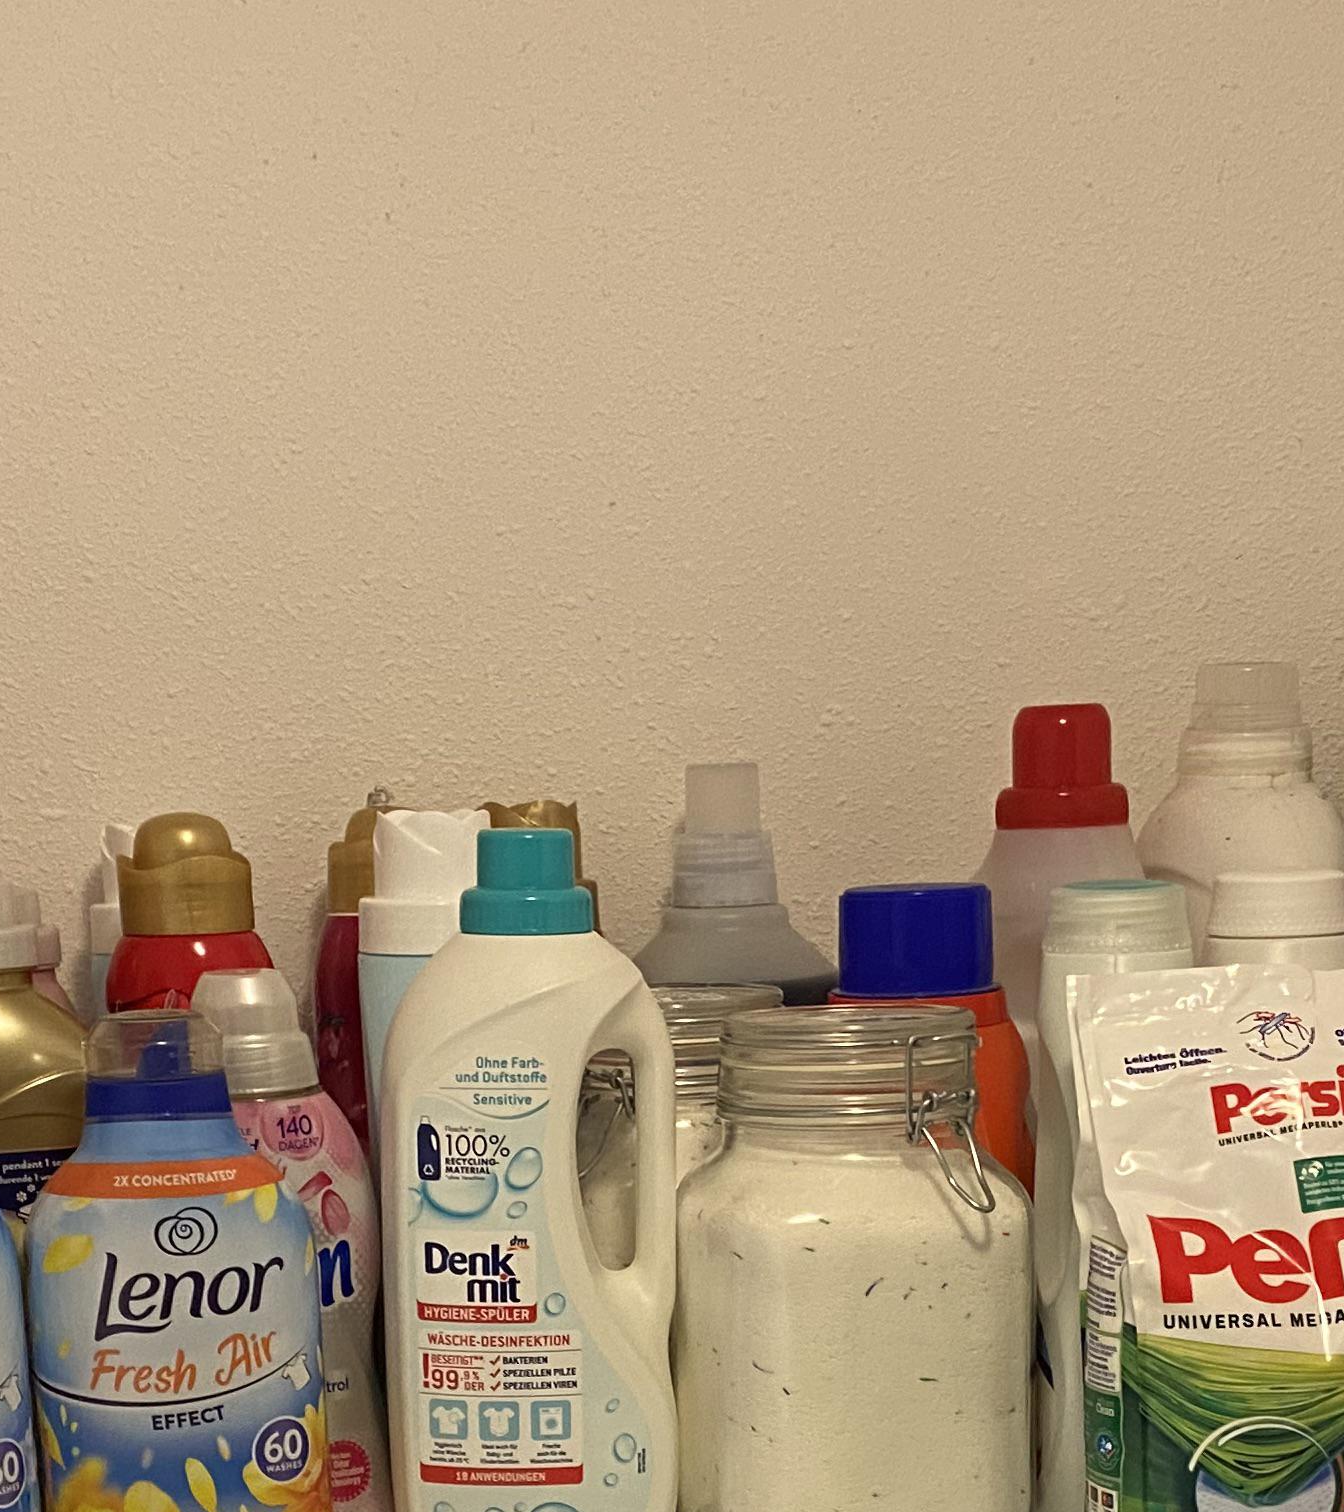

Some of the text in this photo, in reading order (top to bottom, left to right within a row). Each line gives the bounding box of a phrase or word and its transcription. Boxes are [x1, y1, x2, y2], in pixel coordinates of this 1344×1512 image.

[476, 1056, 544, 1069] Ohne Farb-
[456, 1071, 547, 1084] und Duftstoffe
[473, 1093, 532, 1105] Sensitive
[276, 1115, 312, 1138] 140
[445, 1134, 510, 1158] 100%
[445, 1157, 500, 1166] RECYCLING-
[445, 1166, 490, 1174] MATERIAL
[113, 1176, 130, 1187] 2X
[510, 1235, 528, 1248] dm
[424, 1241, 516, 1276] Denk
[467, 1273, 521, 1303] mit
[94, 1250, 284, 1341] Lenor
[424, 1306, 530, 1321] HYGIENE-SPÜLER
[1163, 1311, 1282, 1330] UNIVERSAL
[427, 1332, 570, 1347] WÄSCHE-DESINFEKTION
[90, 1329, 277, 1394] Fresh Air
[503, 1356, 548, 1365] BAKTERIEN
[464, 1382, 485, 1391] DER
[152, 1405, 225, 1431] EFFECT
[263, 1428, 302, 1461] 60
[266, 1460, 303, 1474] WASHES
[470, 1472, 546, 1482] ANWENDUNGEN
